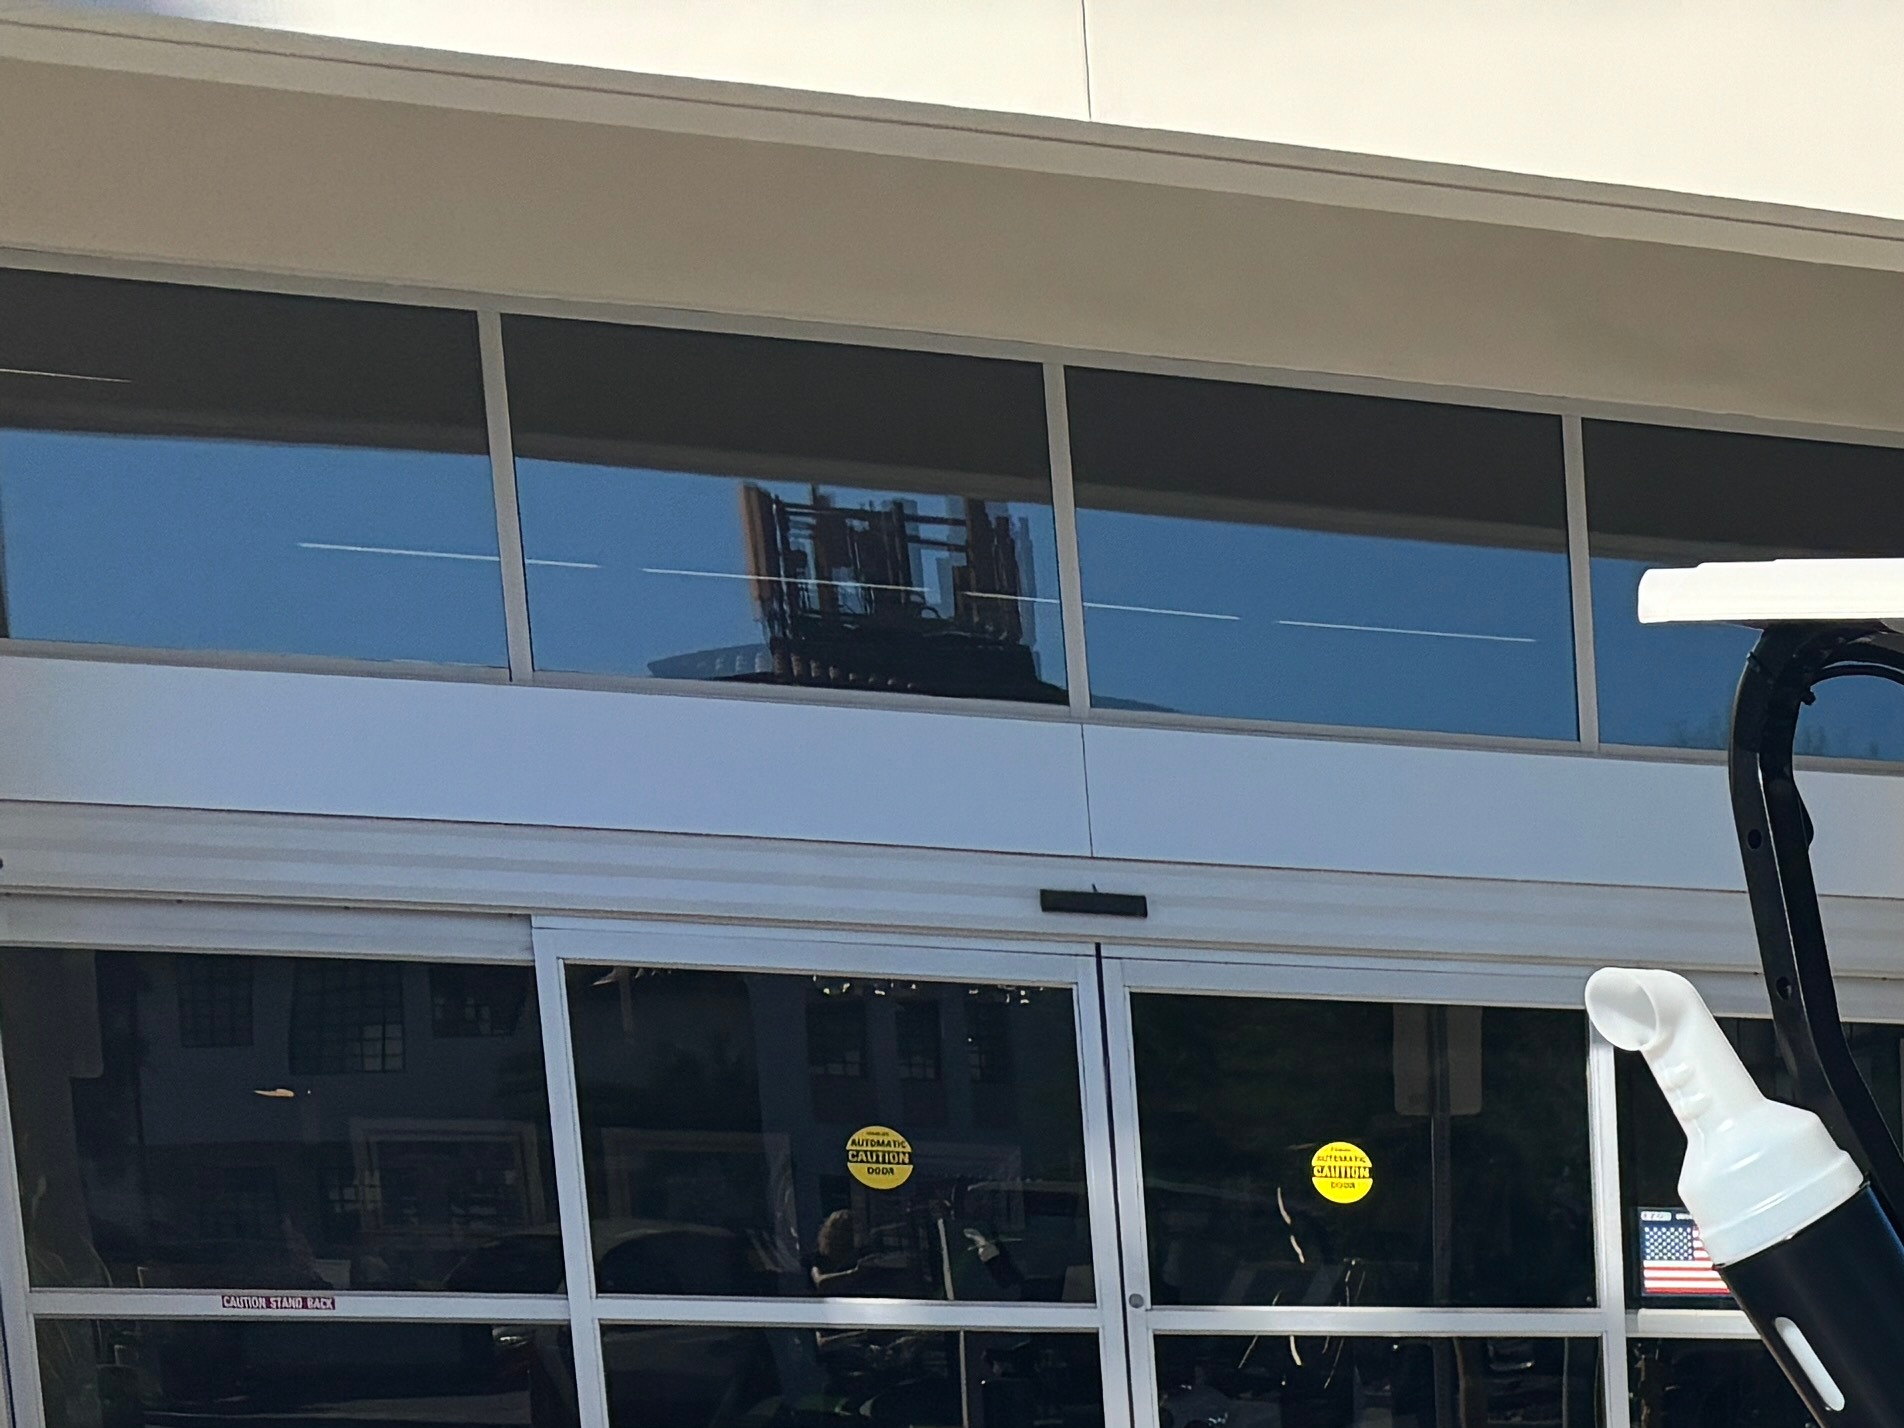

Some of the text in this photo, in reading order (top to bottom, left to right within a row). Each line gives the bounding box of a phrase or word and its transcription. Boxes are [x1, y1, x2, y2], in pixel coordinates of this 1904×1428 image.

[850, 1138, 907, 1149] AUTOMATIC
[848, 1151, 909, 1164] CAUTION
[867, 1167, 894, 1176] DOOR
[1313, 1166, 1369, 1178] CAUTION
[223, 1296, 333, 1310] CAUTION STAND BACK
